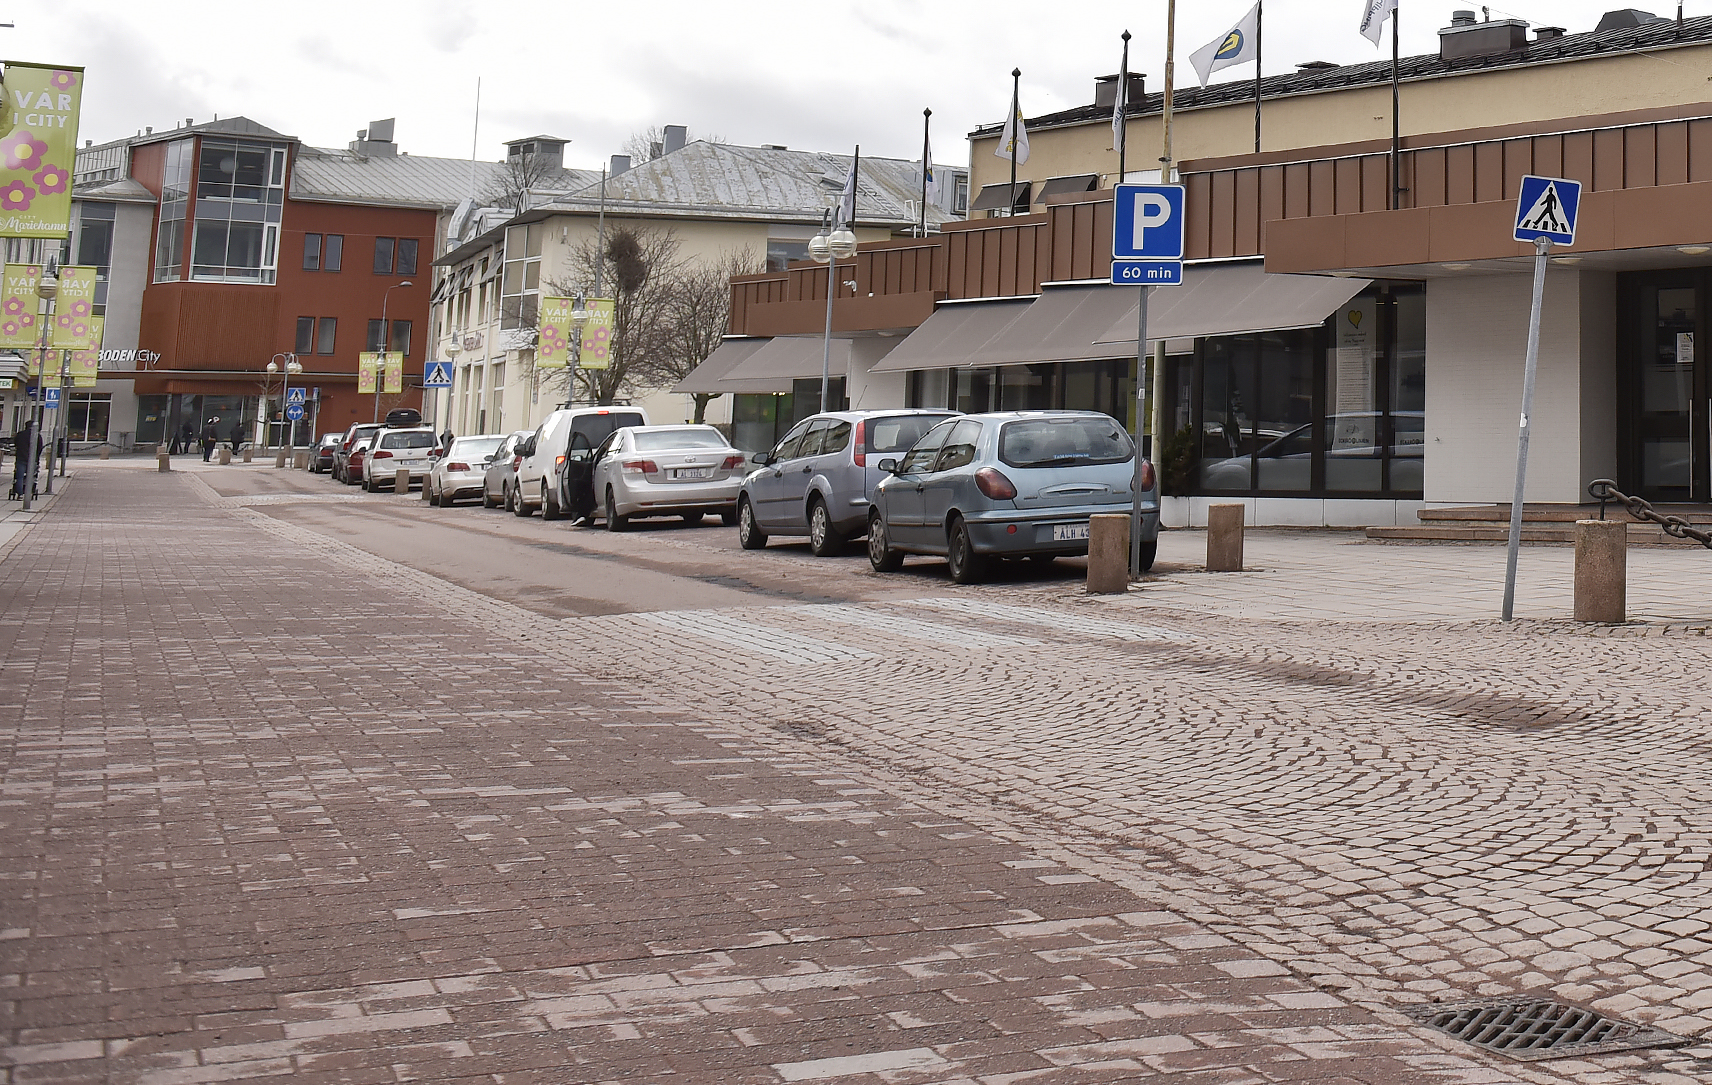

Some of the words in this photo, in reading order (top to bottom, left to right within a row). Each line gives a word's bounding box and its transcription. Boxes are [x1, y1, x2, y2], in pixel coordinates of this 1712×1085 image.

[14, 87, 72, 111] VÅR
[13, 112, 18, 125] I
[24, 113, 69, 128] CITY
[4, 216, 67, 233] Mariehamn
[1132, 192, 1172, 250] P
[1122, 266, 1142, 279] 60
[1147, 266, 1172, 279] min
[138, 348, 161, 364] City
